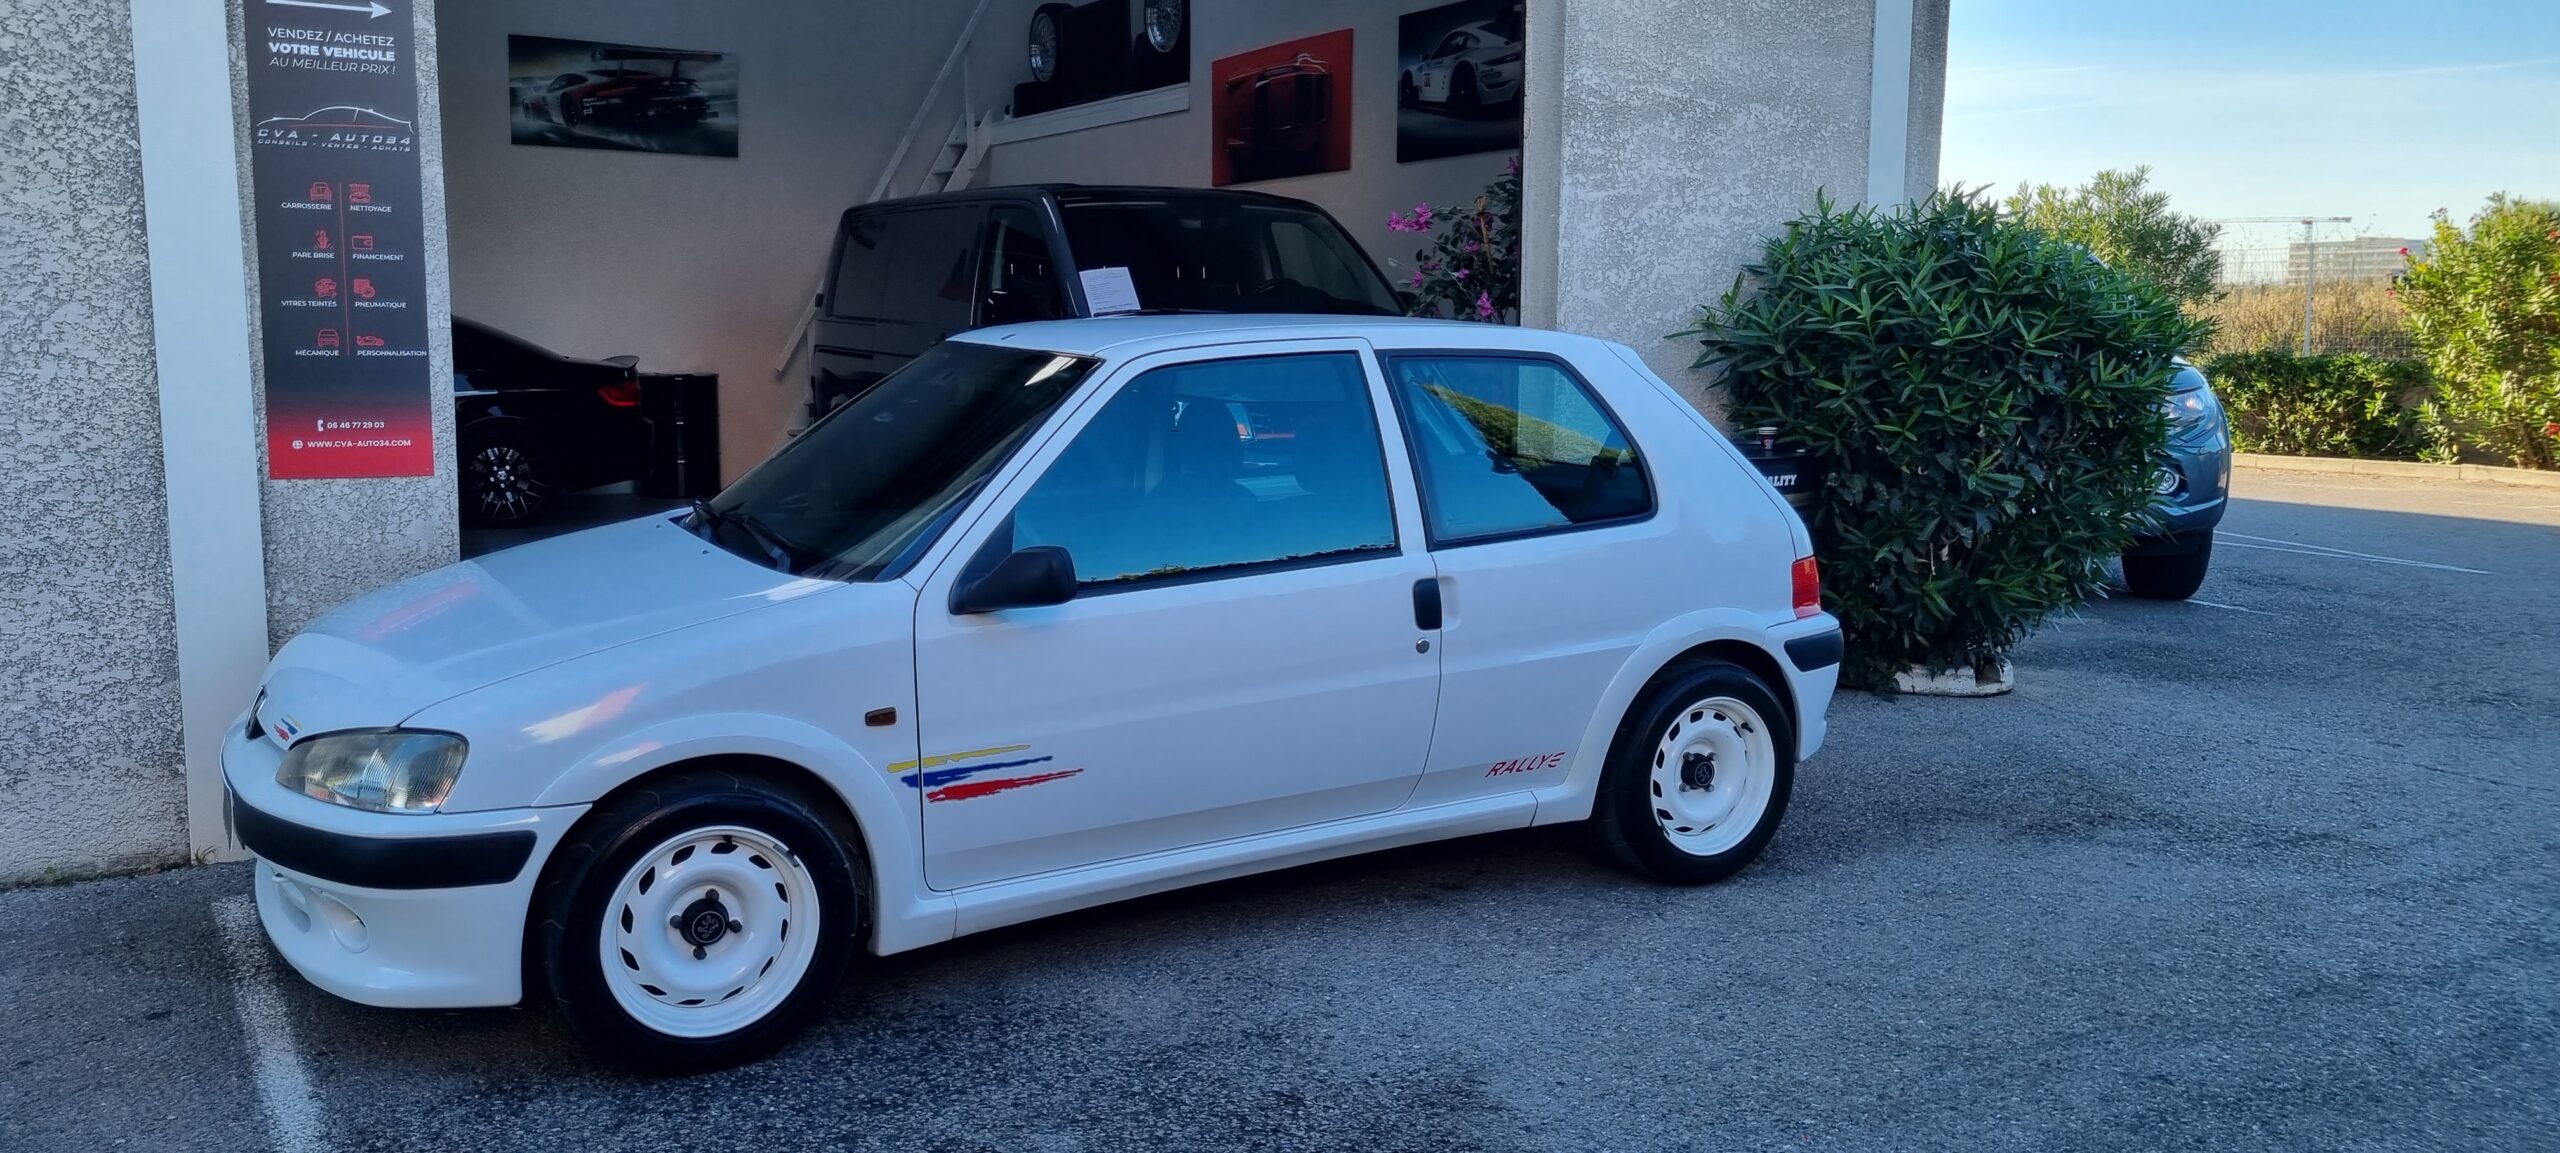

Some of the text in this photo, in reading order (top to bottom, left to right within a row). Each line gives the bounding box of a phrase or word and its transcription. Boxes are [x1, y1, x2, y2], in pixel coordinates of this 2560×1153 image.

[267, 27, 324, 42] VENDEZ
[333, 33, 395, 47] ACHETEZ
[268, 42, 396, 62] VOTRE VEHICULE
[269, 56, 290, 67] AU
[292, 58, 358, 73] MEILLEUR
[360, 63, 391, 75] PRIX
[257, 129, 298, 139] CVA
[257, 138, 308, 147] CONSEILS
[281, 202, 333, 211] CARROSSERIE
[349, 205, 392, 213] NETTOYAGE
[352, 253, 405, 261] FINANCEMENT
[355, 301, 407, 309] PNEUMATIQUE
[327, 421, 338, 429] 06
[351, 421, 362, 429] 77
[362, 421, 373, 429] 29
[374, 421, 385, 429] 03
[307, 440, 411, 448] WWW.CVA-AUTO34.COM
[1764, 474, 1797, 487] ALITY
[1484, 751, 1566, 778] RALLYE
